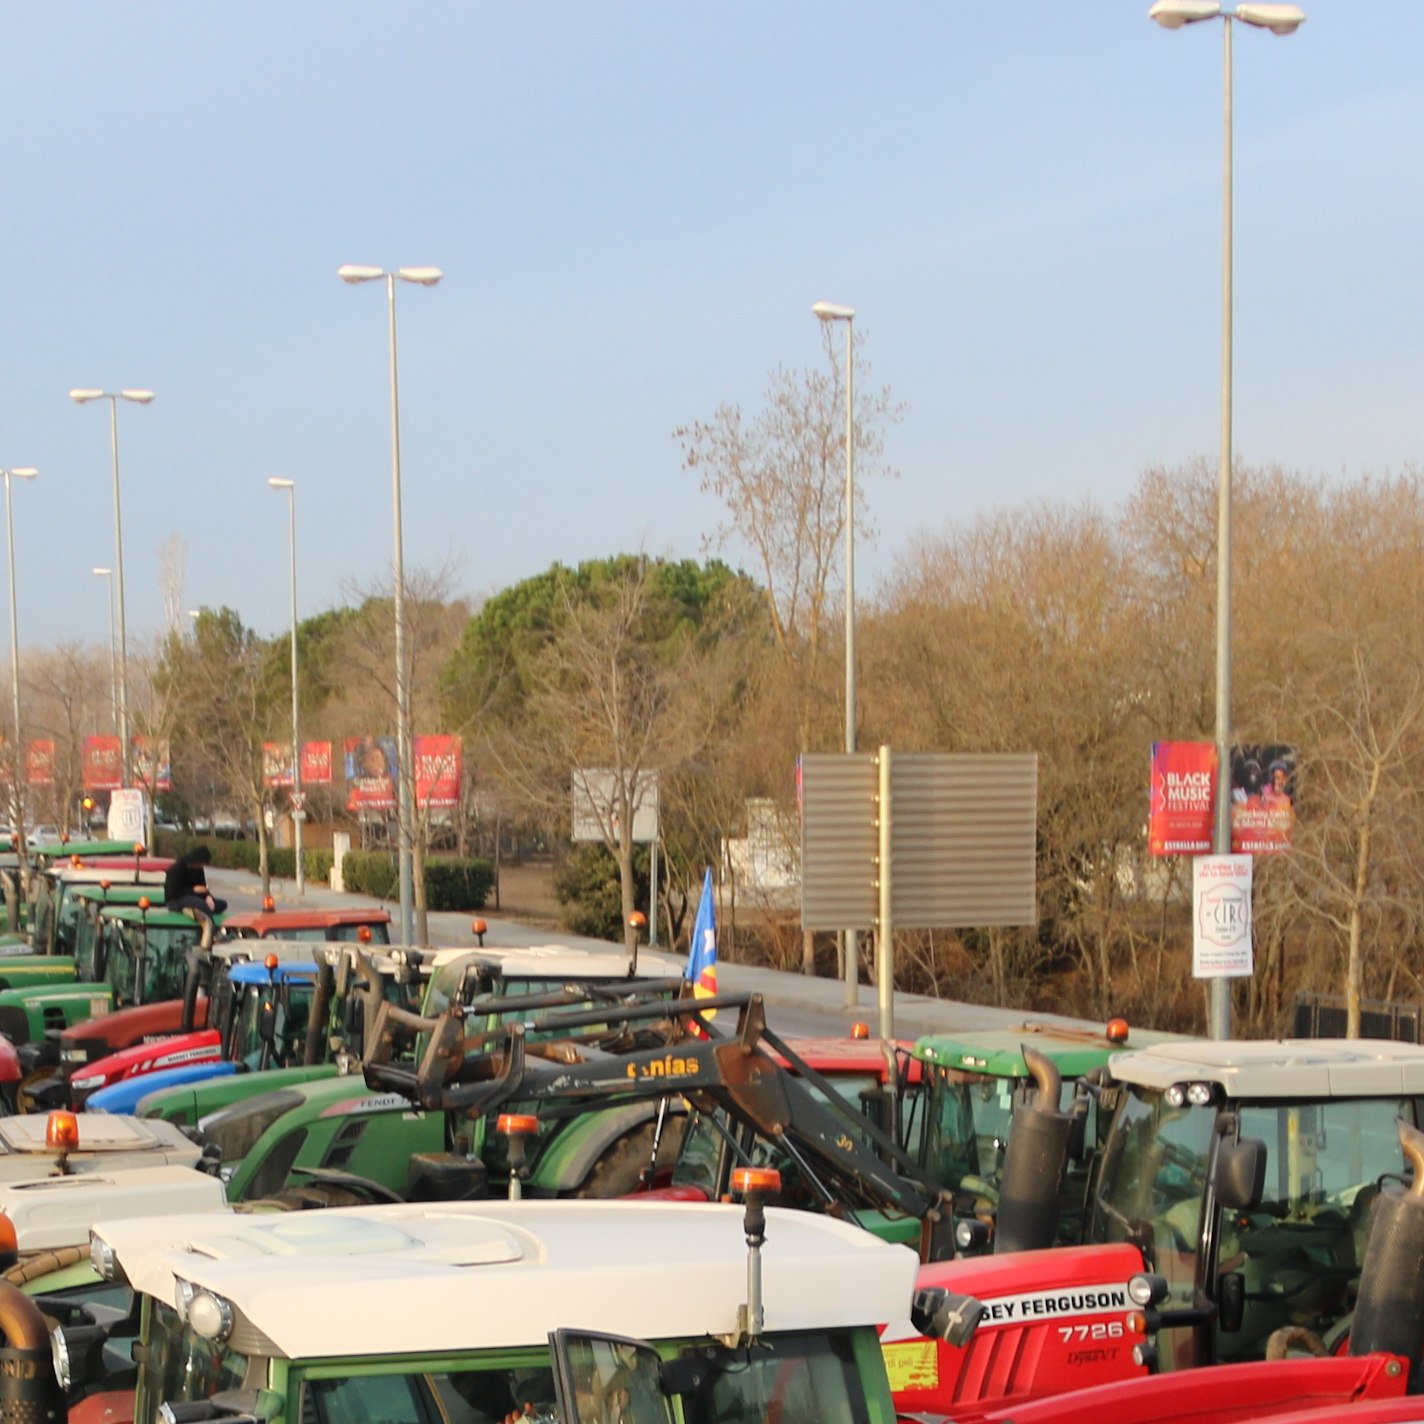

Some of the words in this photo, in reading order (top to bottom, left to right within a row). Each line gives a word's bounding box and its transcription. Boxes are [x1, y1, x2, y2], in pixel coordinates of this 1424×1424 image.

[1167, 772, 1211, 787] BLACK
[1168, 787, 1211, 801] MUSIC
[1168, 801, 1210, 811] FESTIVAL
[360, 1098, 396, 1108] FENDT
[980, 1301, 1022, 1322] SEY
[1022, 1291, 1126, 1316] FERGUSON
[1057, 1320, 1124, 1343] 7726
